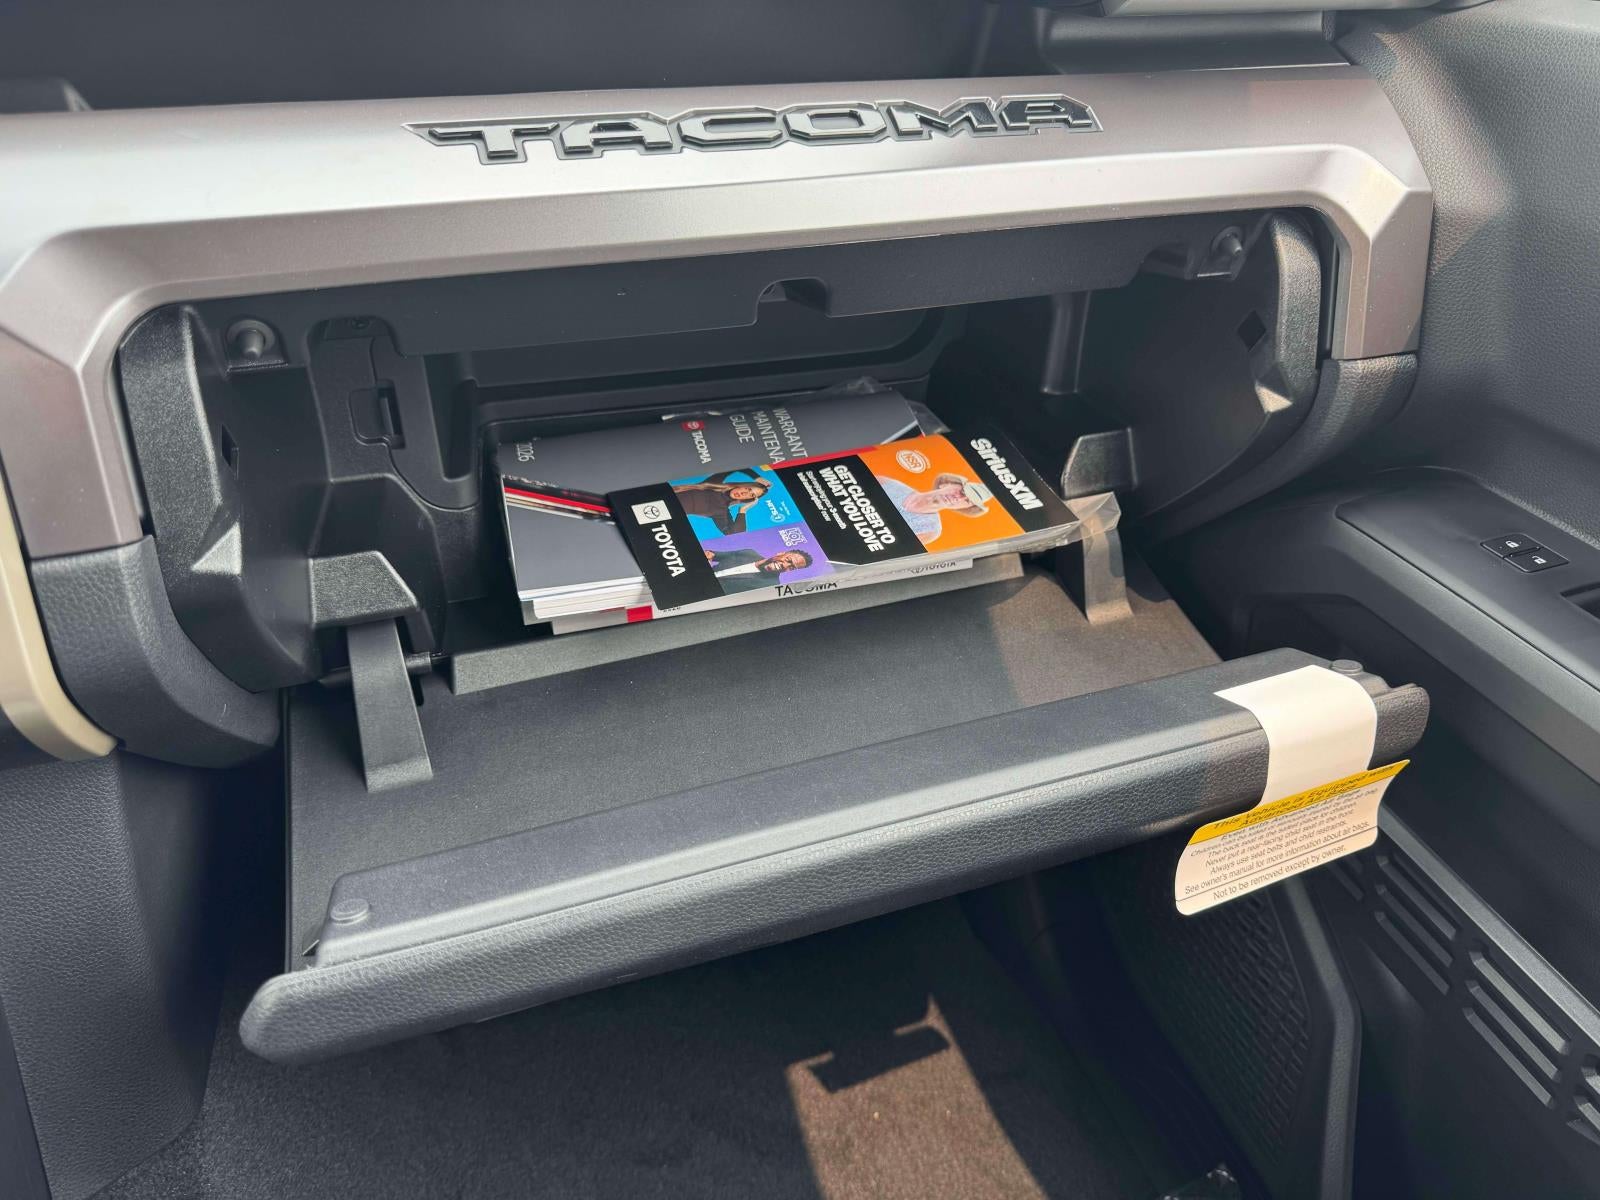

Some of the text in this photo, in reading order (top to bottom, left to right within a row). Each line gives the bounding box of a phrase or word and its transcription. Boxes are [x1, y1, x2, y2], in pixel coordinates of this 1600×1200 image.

[408, 93, 1101, 163] TACOMA
[691, 430, 711, 464] TACOMA
[730, 414, 755, 443] GUIDE
[753, 410, 786, 465] MAINTENA
[772, 407, 808, 457] WARRANT
[970, 437, 1043, 510] SiriusXM
[819, 466, 884, 552] WHAT YOU LOVE
[834, 464, 896, 544] GET CLOSER TO
[652, 524, 686, 578] TOYOTA
[1185, 882, 1198, 895] See
[1200, 871, 1226, 889] owner's
[1228, 862, 1253, 878] manual
[1285, 837, 1320, 856] information
[1322, 829, 1340, 842] about
[1213, 887, 1228, 900] Not
[1250, 866, 1283, 886] removed
[1285, 856, 1309, 873] except
[1322, 844, 1345, 859] owner.
